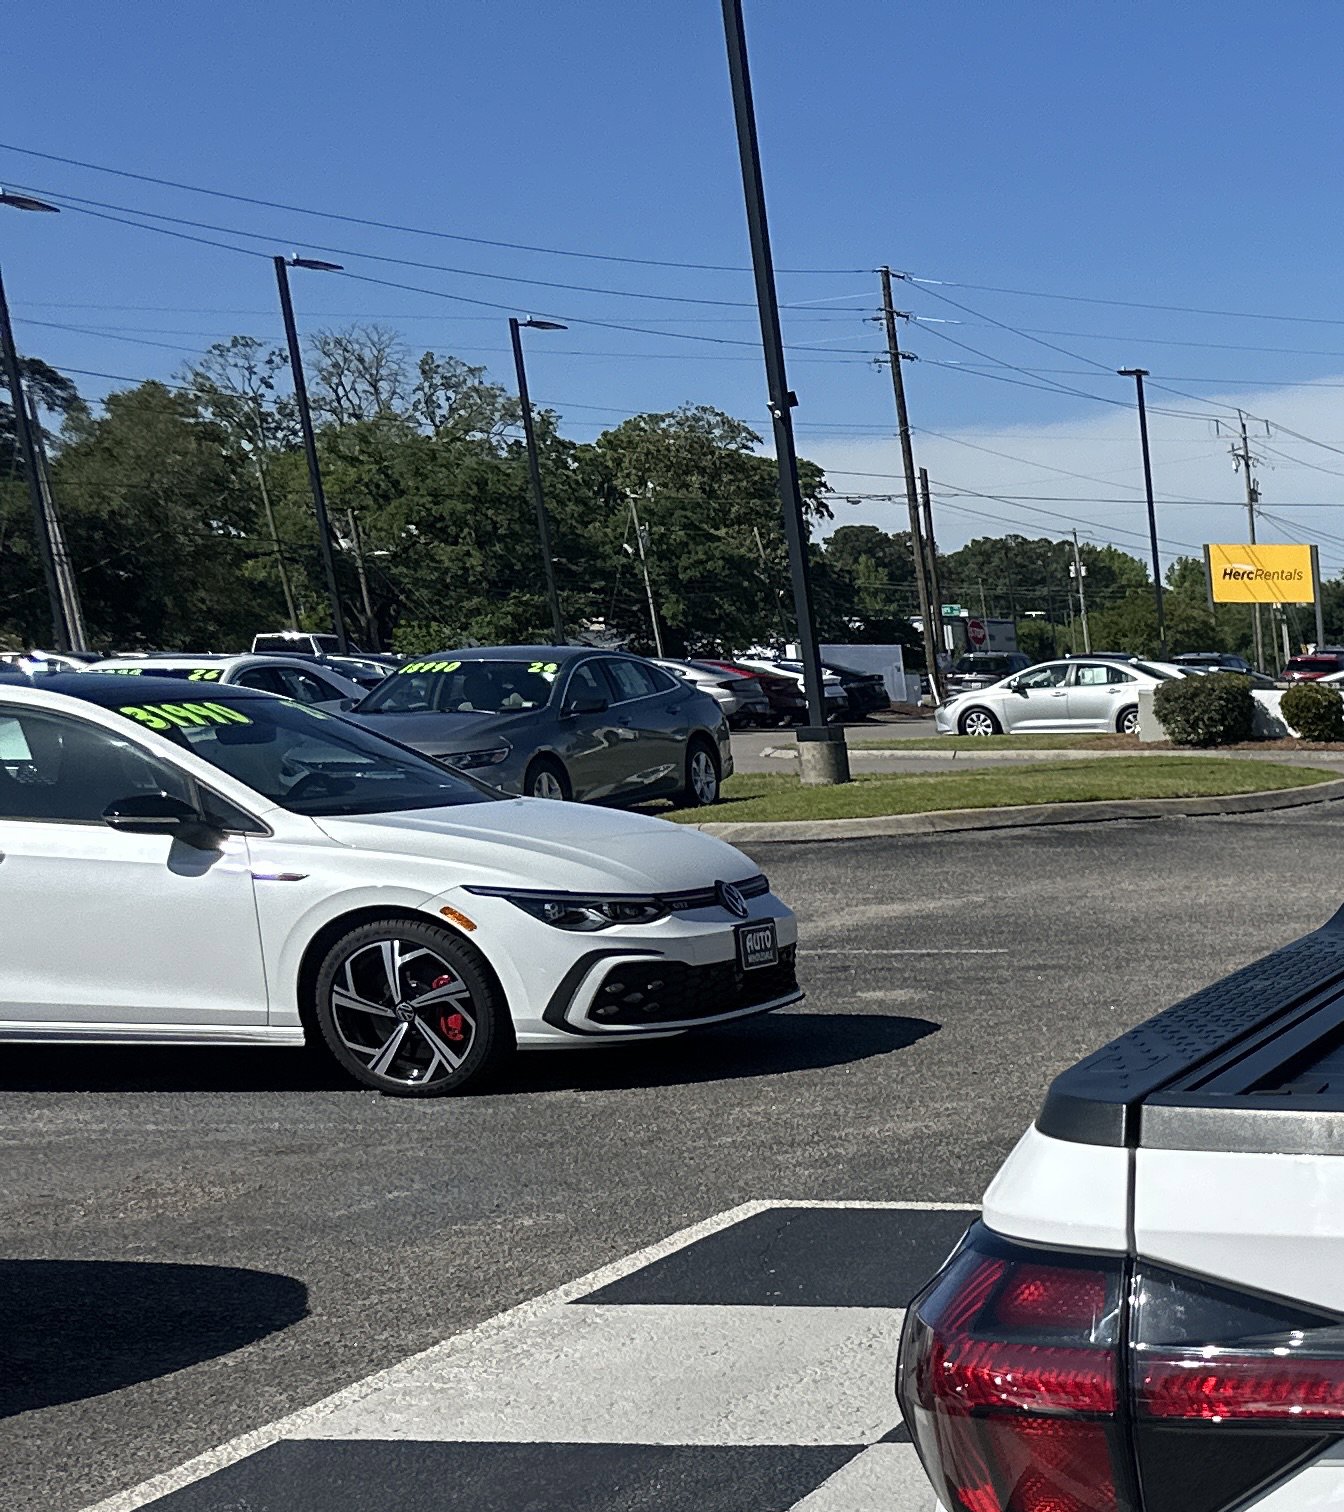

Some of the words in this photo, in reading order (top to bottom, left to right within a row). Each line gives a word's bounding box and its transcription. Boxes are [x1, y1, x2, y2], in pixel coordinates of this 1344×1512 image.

[1222, 567, 1304, 581] HercRentals
[119, 702, 254, 730] 31990
[746, 930, 772, 954] AUTO
